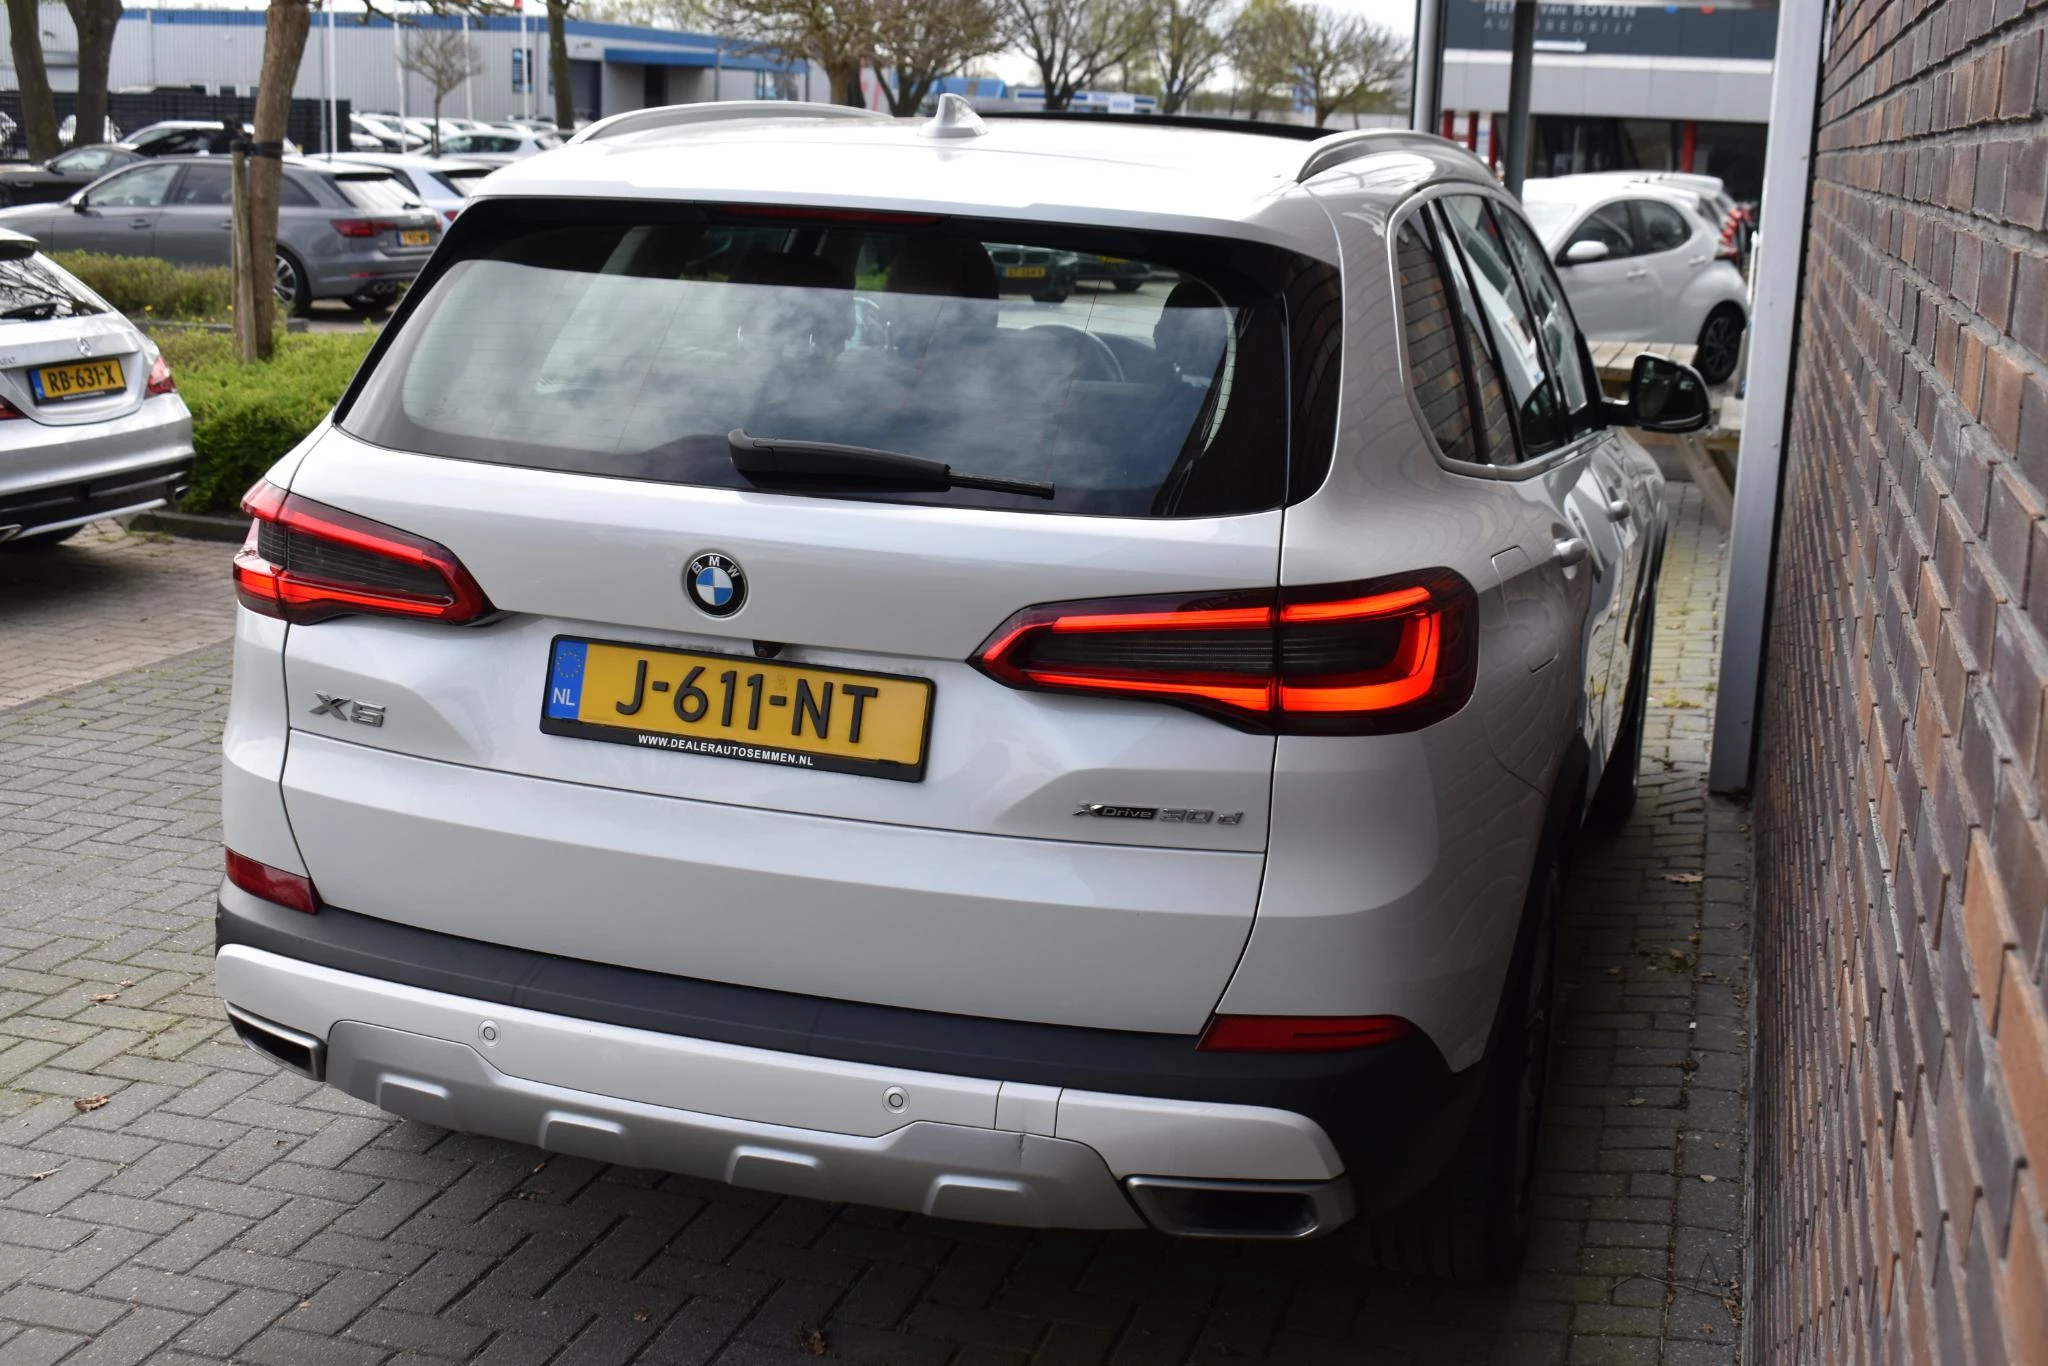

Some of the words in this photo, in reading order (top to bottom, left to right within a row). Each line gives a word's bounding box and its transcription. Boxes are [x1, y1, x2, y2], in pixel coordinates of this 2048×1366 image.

[1573, 5, 1637, 18] BOVEN
[1484, 18, 1633, 35] AUBEDRIJF
[47, 364, 117, 393] RB-631-X
[691, 555, 740, 579] BMW
[308, 690, 386, 728] X5
[552, 686, 576, 707] NL
[615, 659, 878, 744] J-611-NT
[638, 734, 814, 767] WWW.DEALERAUTOSEMMEN.NL
